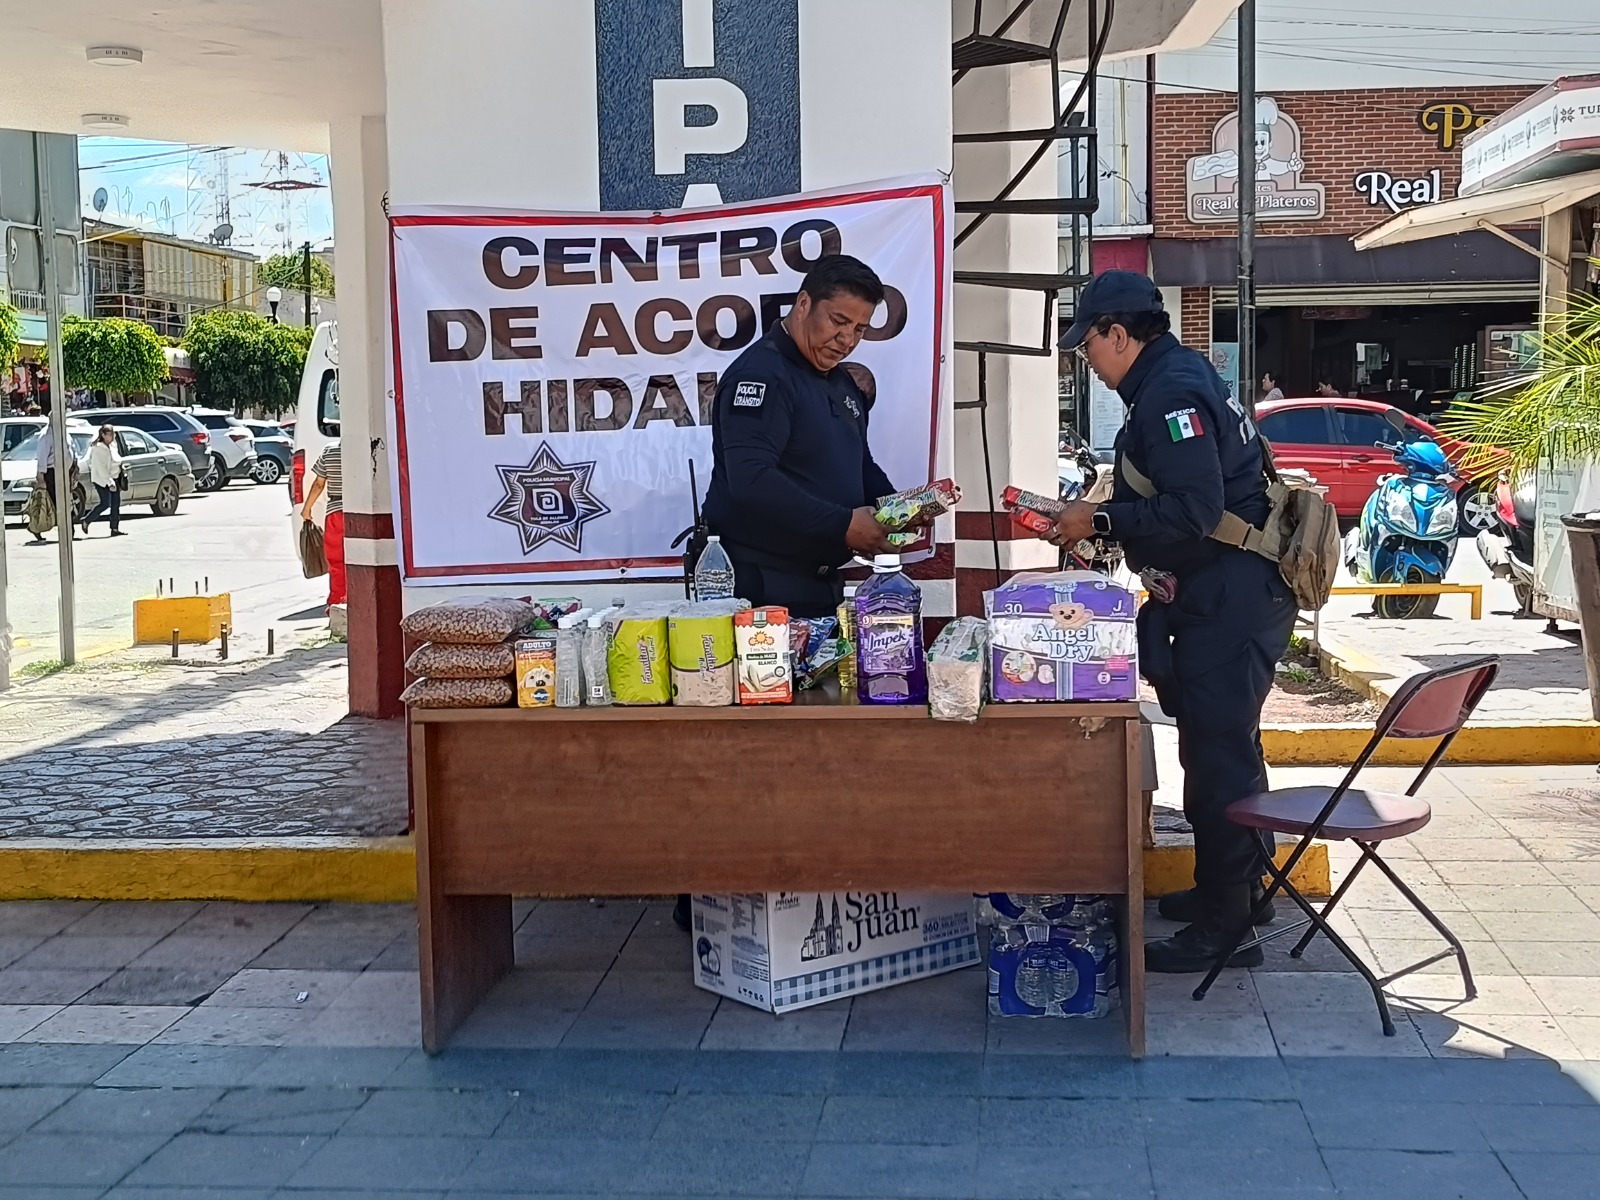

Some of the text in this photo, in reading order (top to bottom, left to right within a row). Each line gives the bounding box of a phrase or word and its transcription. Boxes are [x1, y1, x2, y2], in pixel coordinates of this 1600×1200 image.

[1355, 168, 1441, 214] Real
[1196, 196, 1232, 216] Real
[1257, 194, 1316, 209] Plateros
[482, 219, 842, 290] CENTRO
[427, 306, 543, 362] DE
[1164, 407, 1197, 421] MÉXICO
[1004, 603, 1023, 615] 30
[1112, 600, 1122, 612] J
[523, 641, 552, 649] ADULTO
[1032, 624, 1095, 646] Angel
[1049, 642, 1093, 661] Dry
[847, 906, 919, 953] Juan
